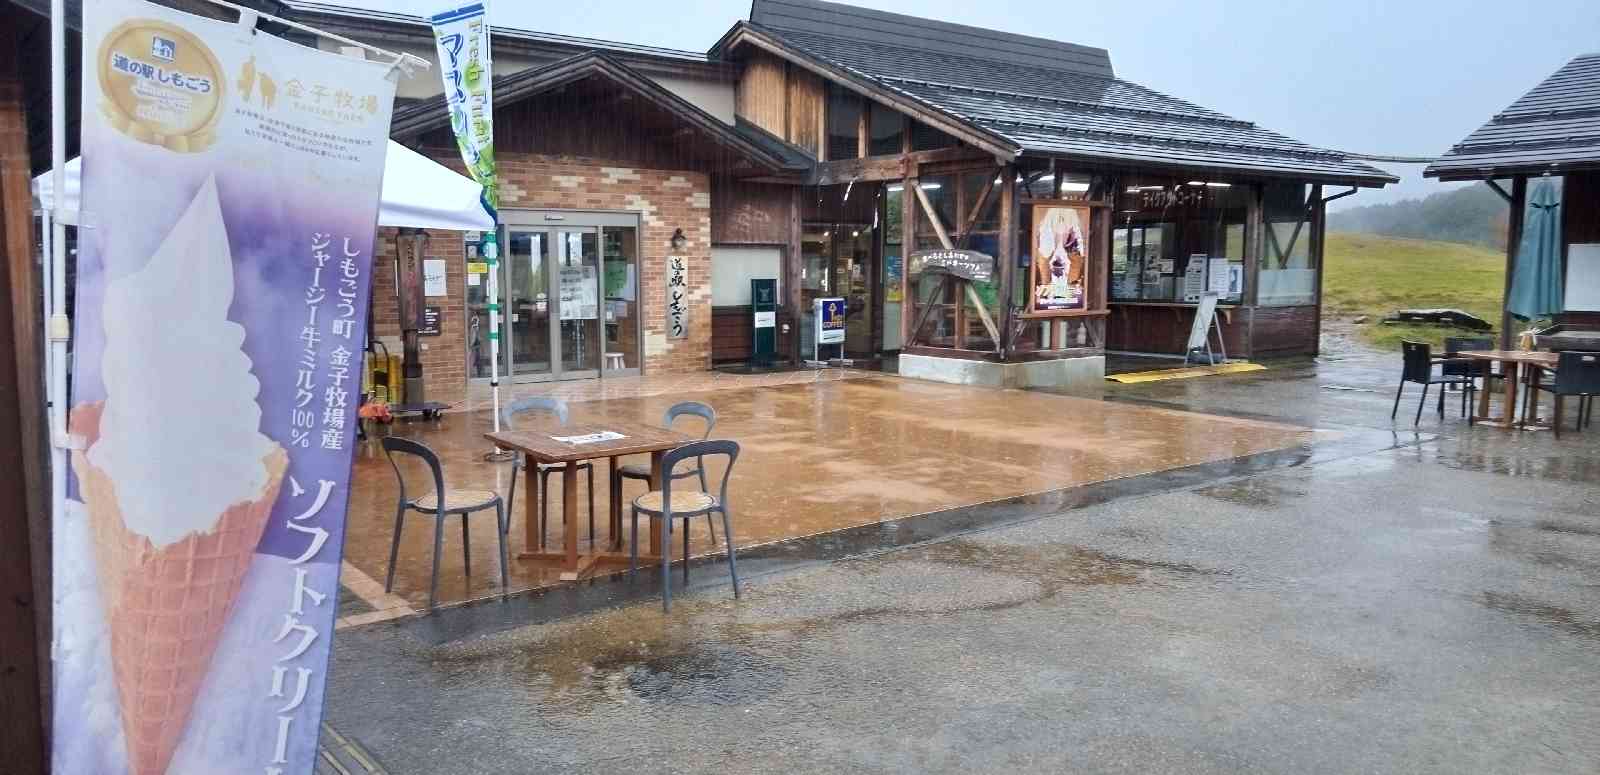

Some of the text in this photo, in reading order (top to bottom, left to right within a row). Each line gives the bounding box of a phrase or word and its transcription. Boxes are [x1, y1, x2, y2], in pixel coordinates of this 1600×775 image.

[112, 53, 212, 93] 道の駅 しもごう
[668, 257, 687, 337] 道の駅 しもごう
[320, 237, 361, 450] しもごう町 金子牧場産
